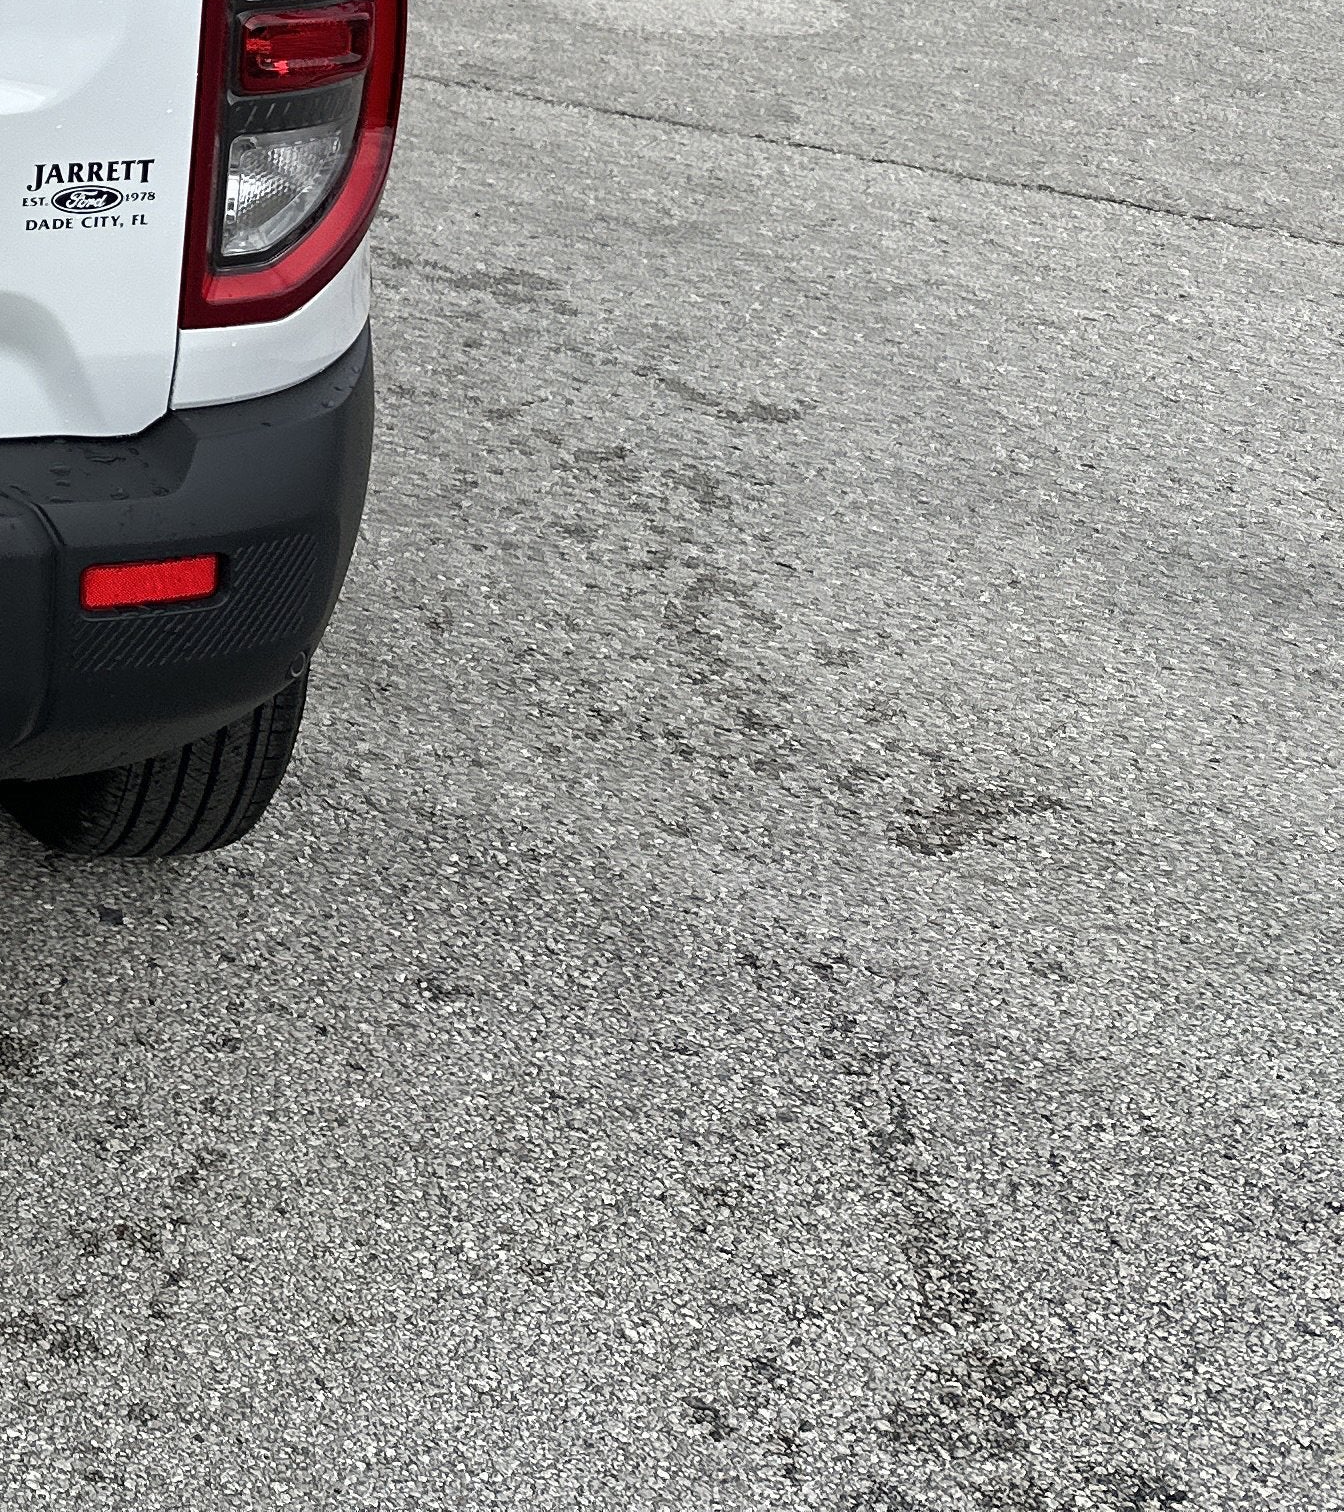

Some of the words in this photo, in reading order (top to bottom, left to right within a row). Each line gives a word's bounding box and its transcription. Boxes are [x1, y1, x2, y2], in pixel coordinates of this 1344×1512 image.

[26, 159, 155, 191] JARRETT
[22, 197, 49, 207] EST.
[66, 191, 107, 209] Ford
[125, 191, 156, 202] 1978
[25, 218, 73, 231] DADE
[81, 215, 124, 229] CITY,
[132, 214, 148, 226] FL
